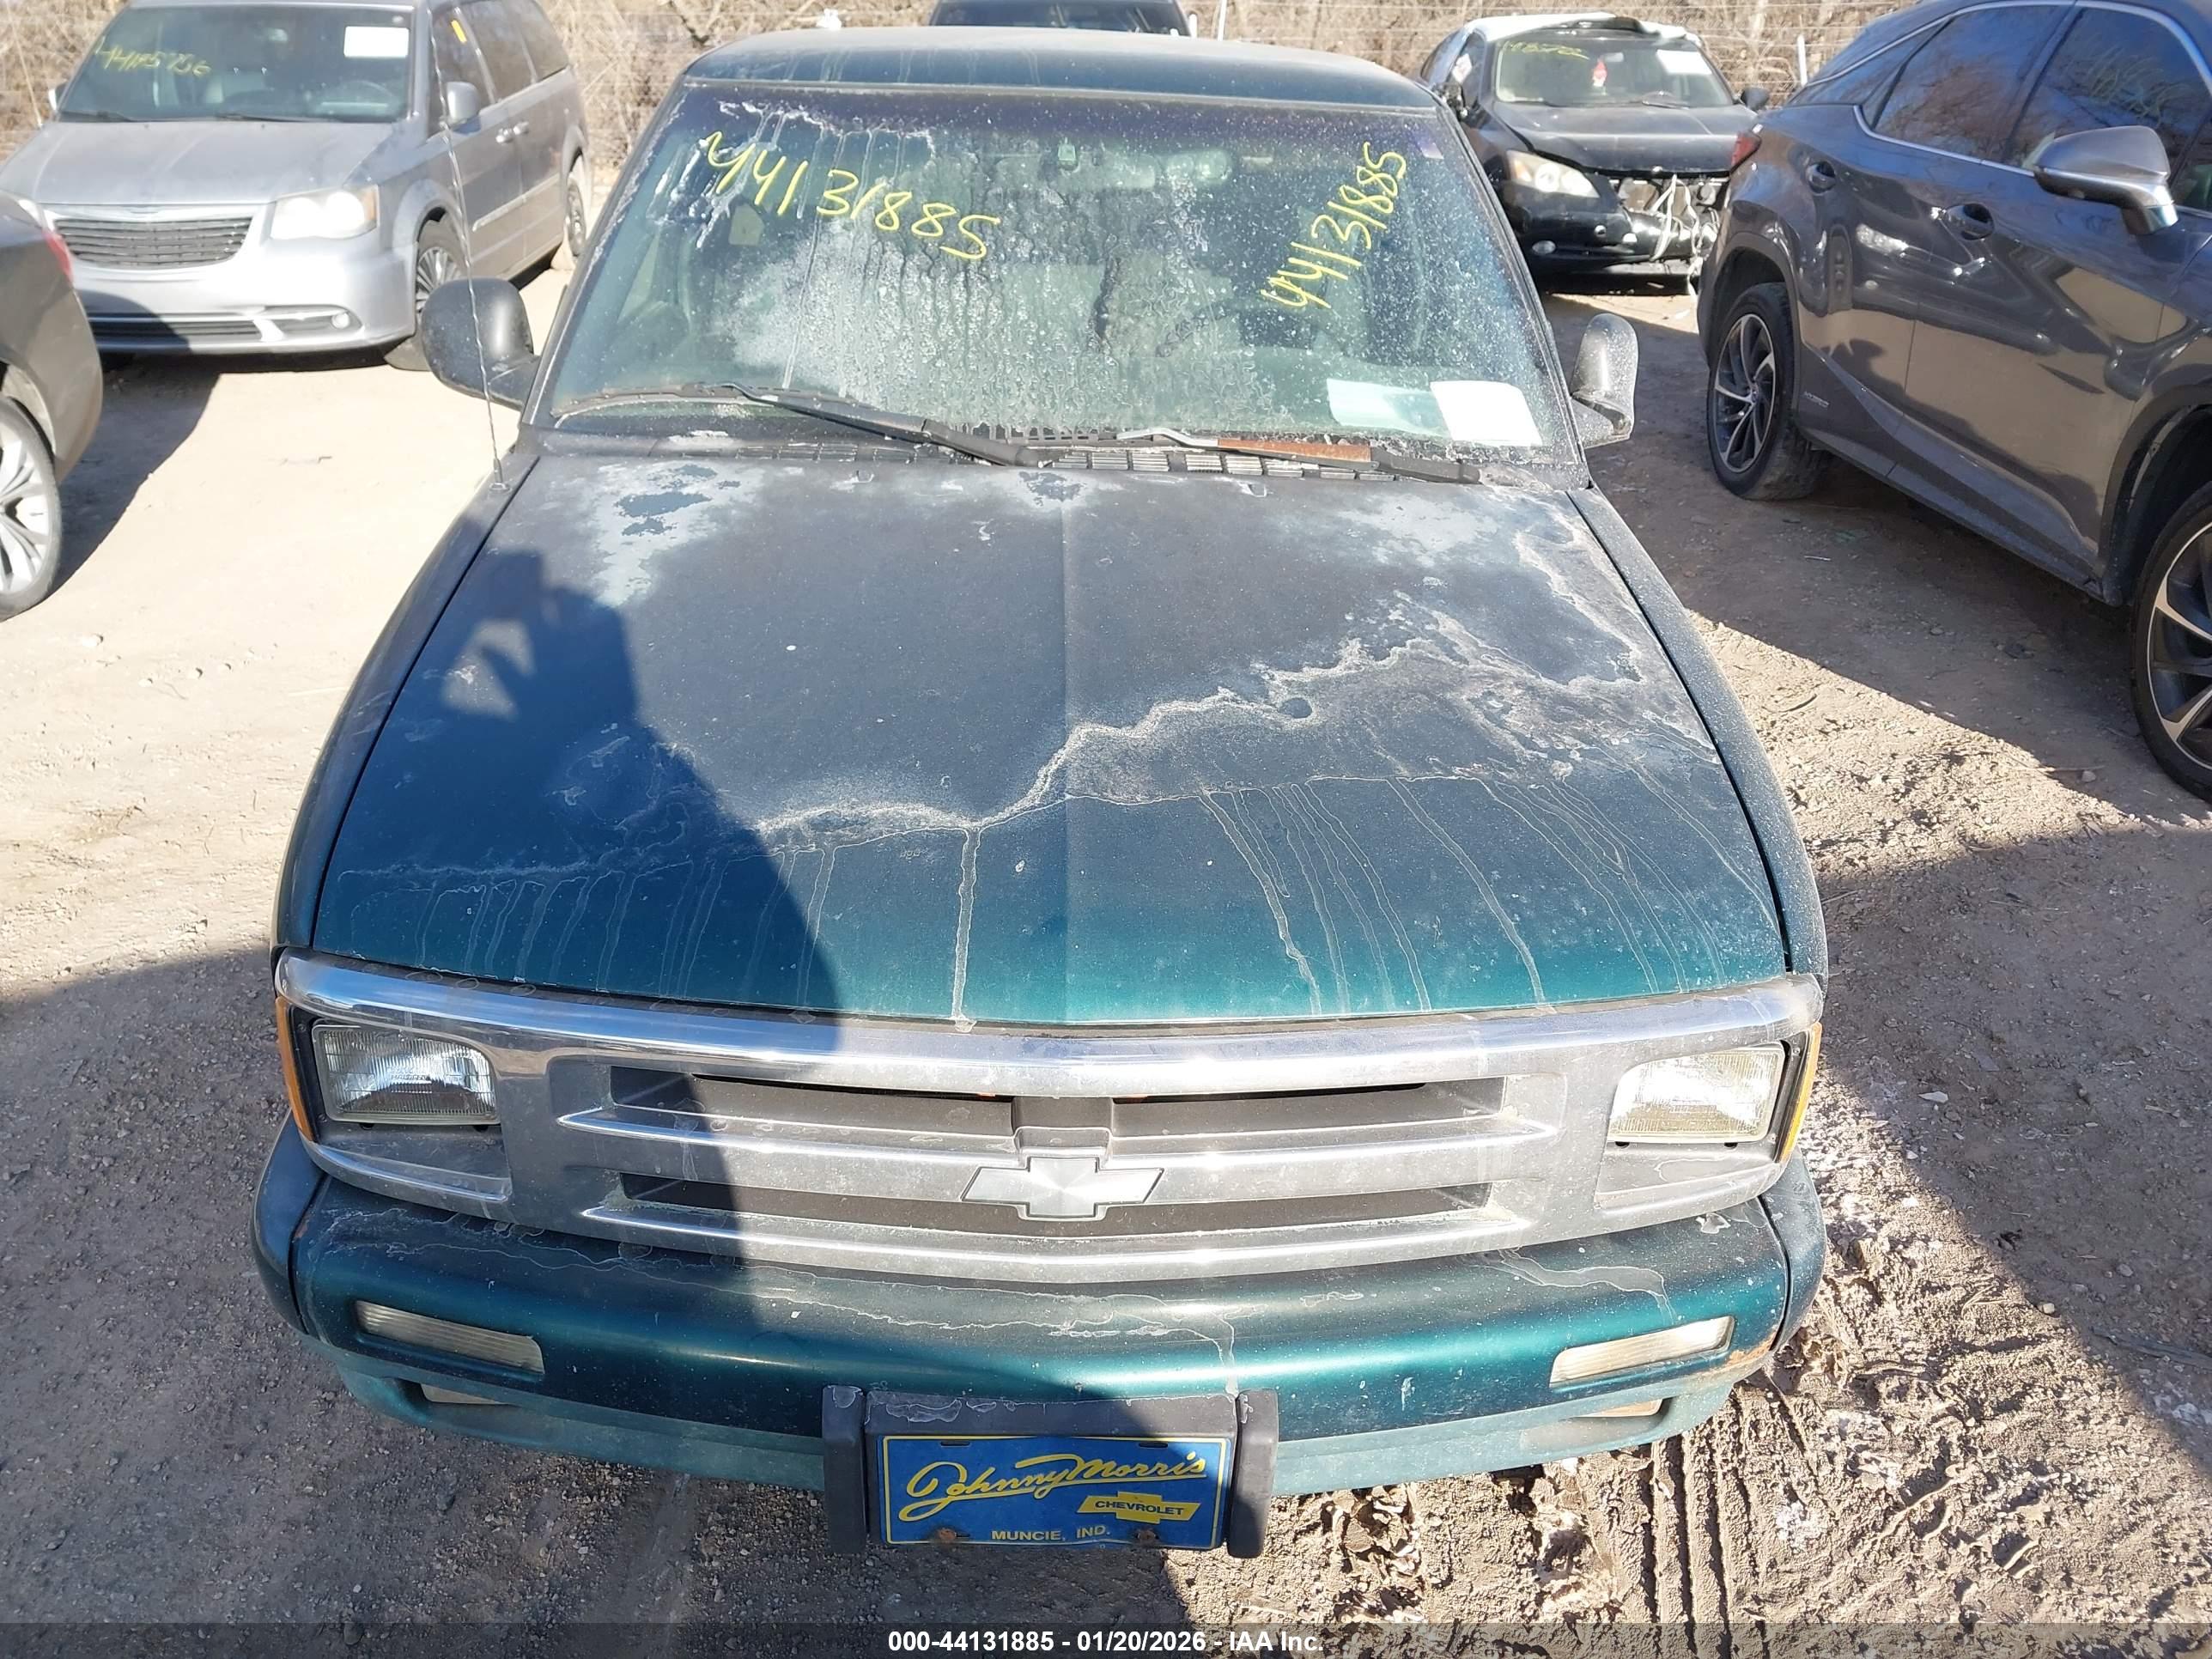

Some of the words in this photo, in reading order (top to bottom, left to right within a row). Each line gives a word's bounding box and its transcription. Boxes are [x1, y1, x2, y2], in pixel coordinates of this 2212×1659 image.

[699, 131, 1000, 259] 44131885
[1260, 141, 1407, 308] 44131885
[898, 1461, 1069, 1522] Johnny
[1095, 1499, 1185, 1516] CHEVROLET
[1076, 1525, 1111, 1539] IND.
